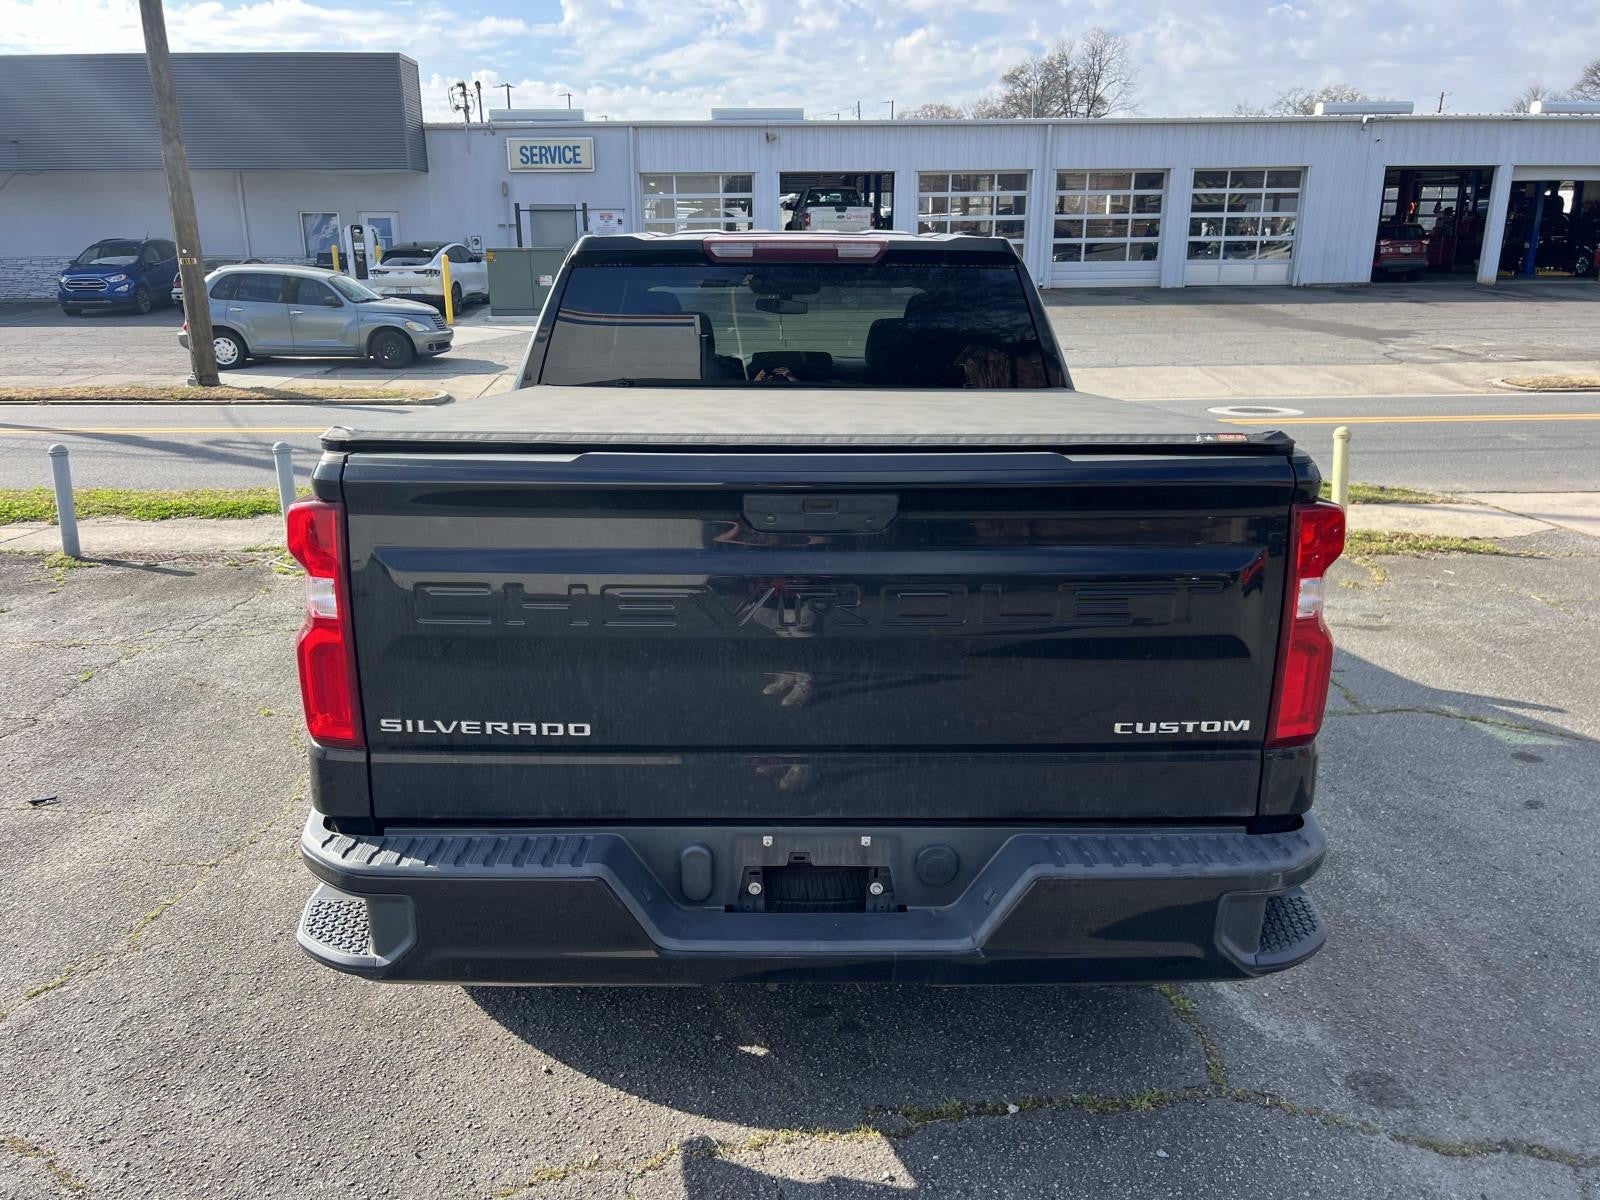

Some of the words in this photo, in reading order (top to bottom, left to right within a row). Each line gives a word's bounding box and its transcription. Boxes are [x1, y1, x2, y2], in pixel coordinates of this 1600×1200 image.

[519, 145, 582, 164] SERVICE
[413, 582, 1227, 627] CHEVROLET
[379, 718, 592, 737] SILVERADO
[1113, 719, 1251, 734] CUSTOM
